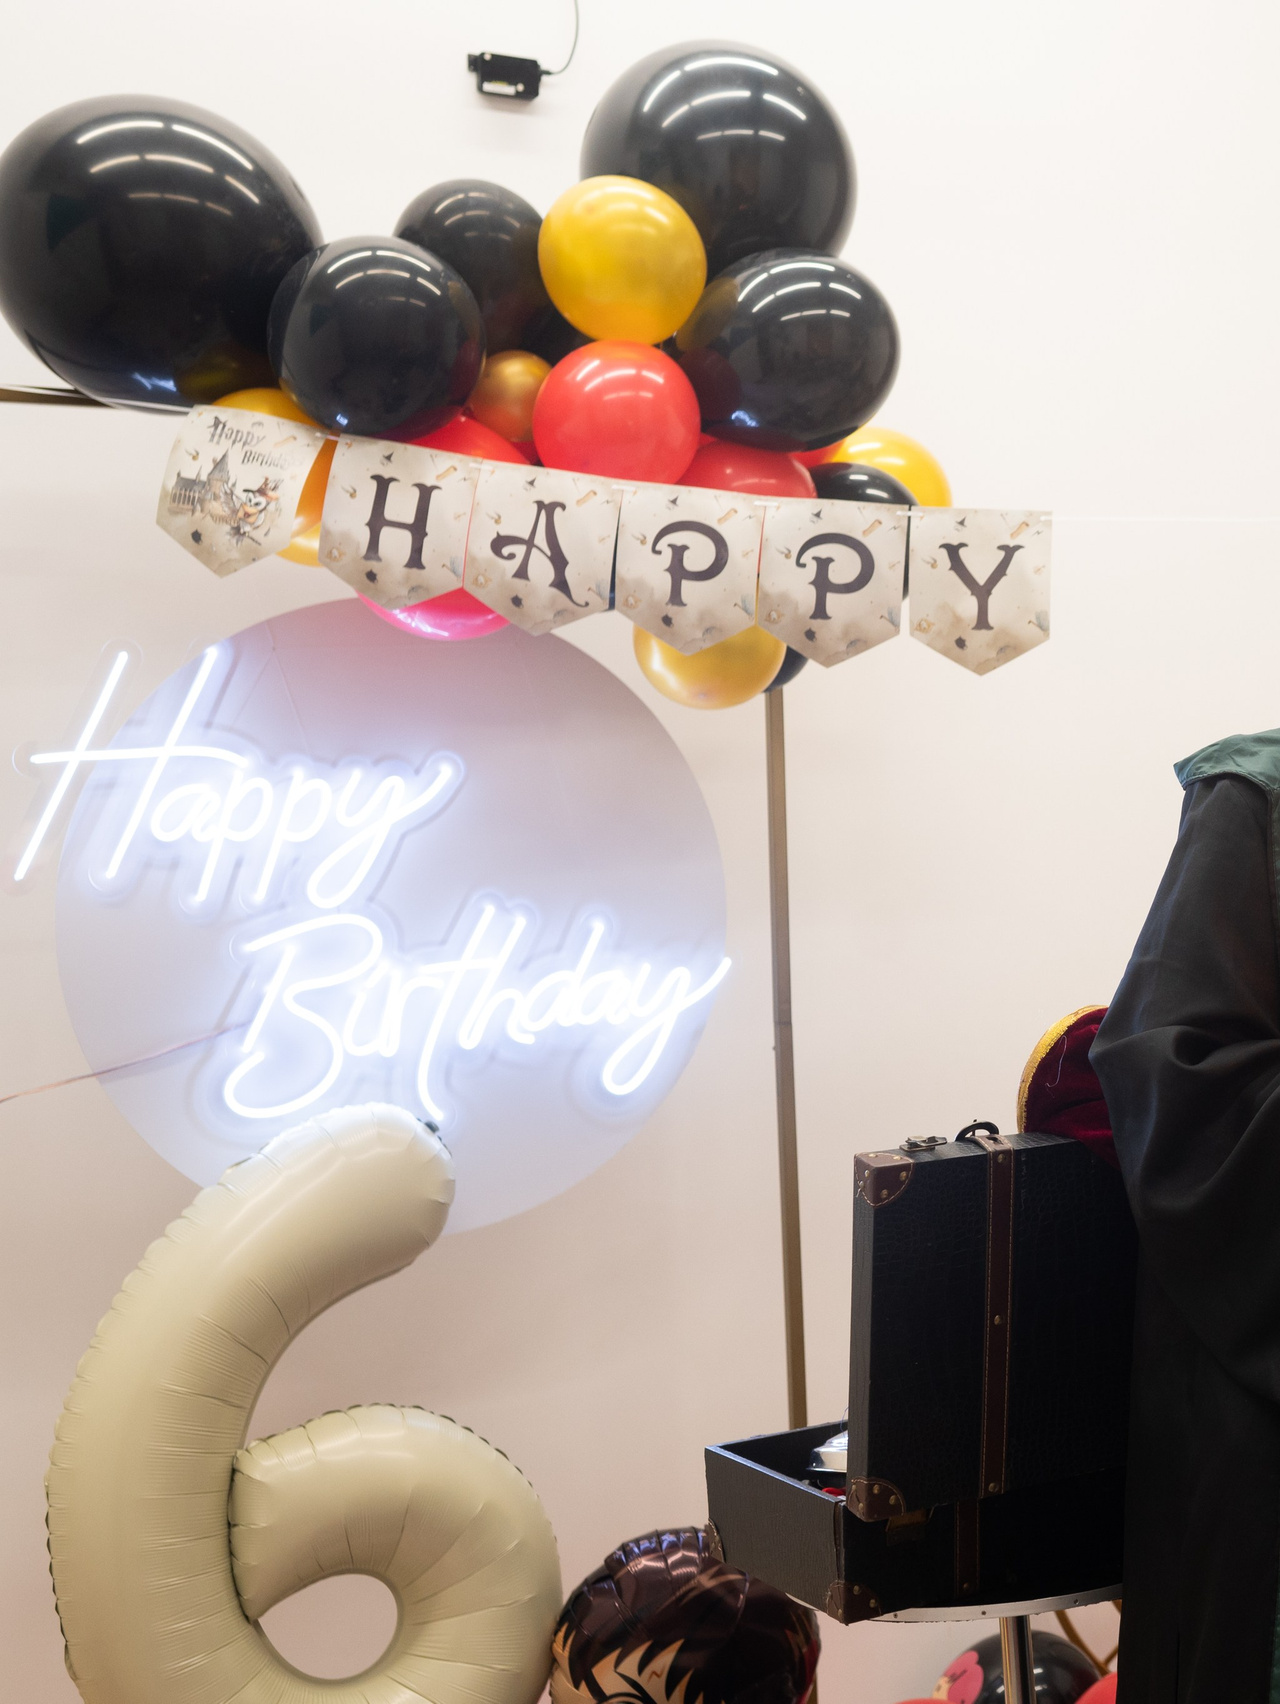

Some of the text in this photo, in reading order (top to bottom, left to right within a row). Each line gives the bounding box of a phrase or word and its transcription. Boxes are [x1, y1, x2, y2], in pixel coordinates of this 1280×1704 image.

[207, 415, 266, 451] Happy
[241, 449, 302, 471] Birthda
[362, 473, 1025, 631] HAPPY
[14, 648, 455, 909] Happy
[223, 906, 733, 1121] Birthday
[45, 1102, 561, 1704] 6
